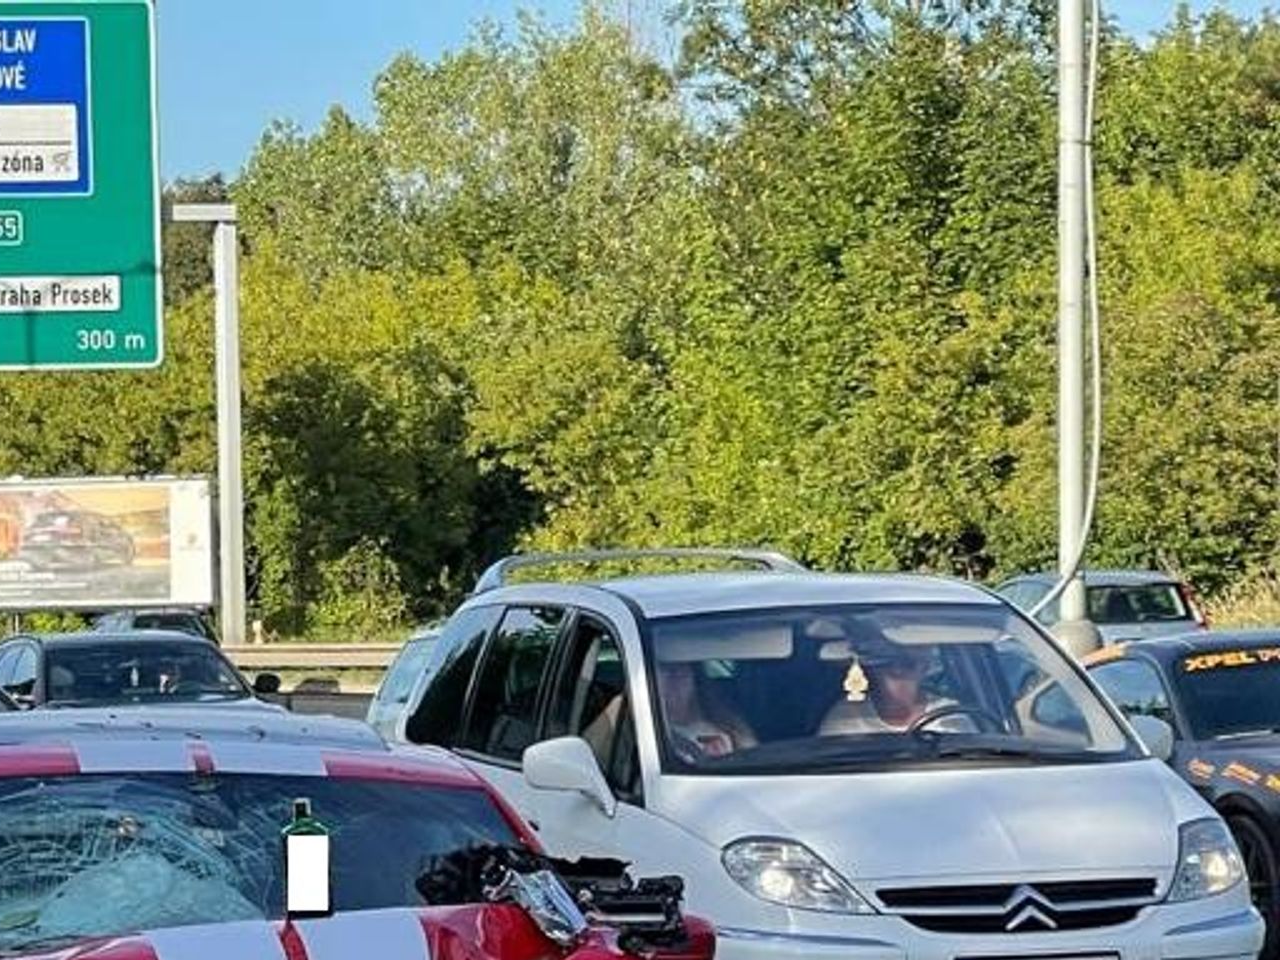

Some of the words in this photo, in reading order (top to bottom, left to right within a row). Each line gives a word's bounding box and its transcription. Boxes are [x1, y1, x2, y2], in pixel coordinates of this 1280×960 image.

[2, 151, 44, 174] zóna
[51, 282, 114, 305] Prosek
[77, 330, 115, 350] 300
[124, 333, 145, 349] m
